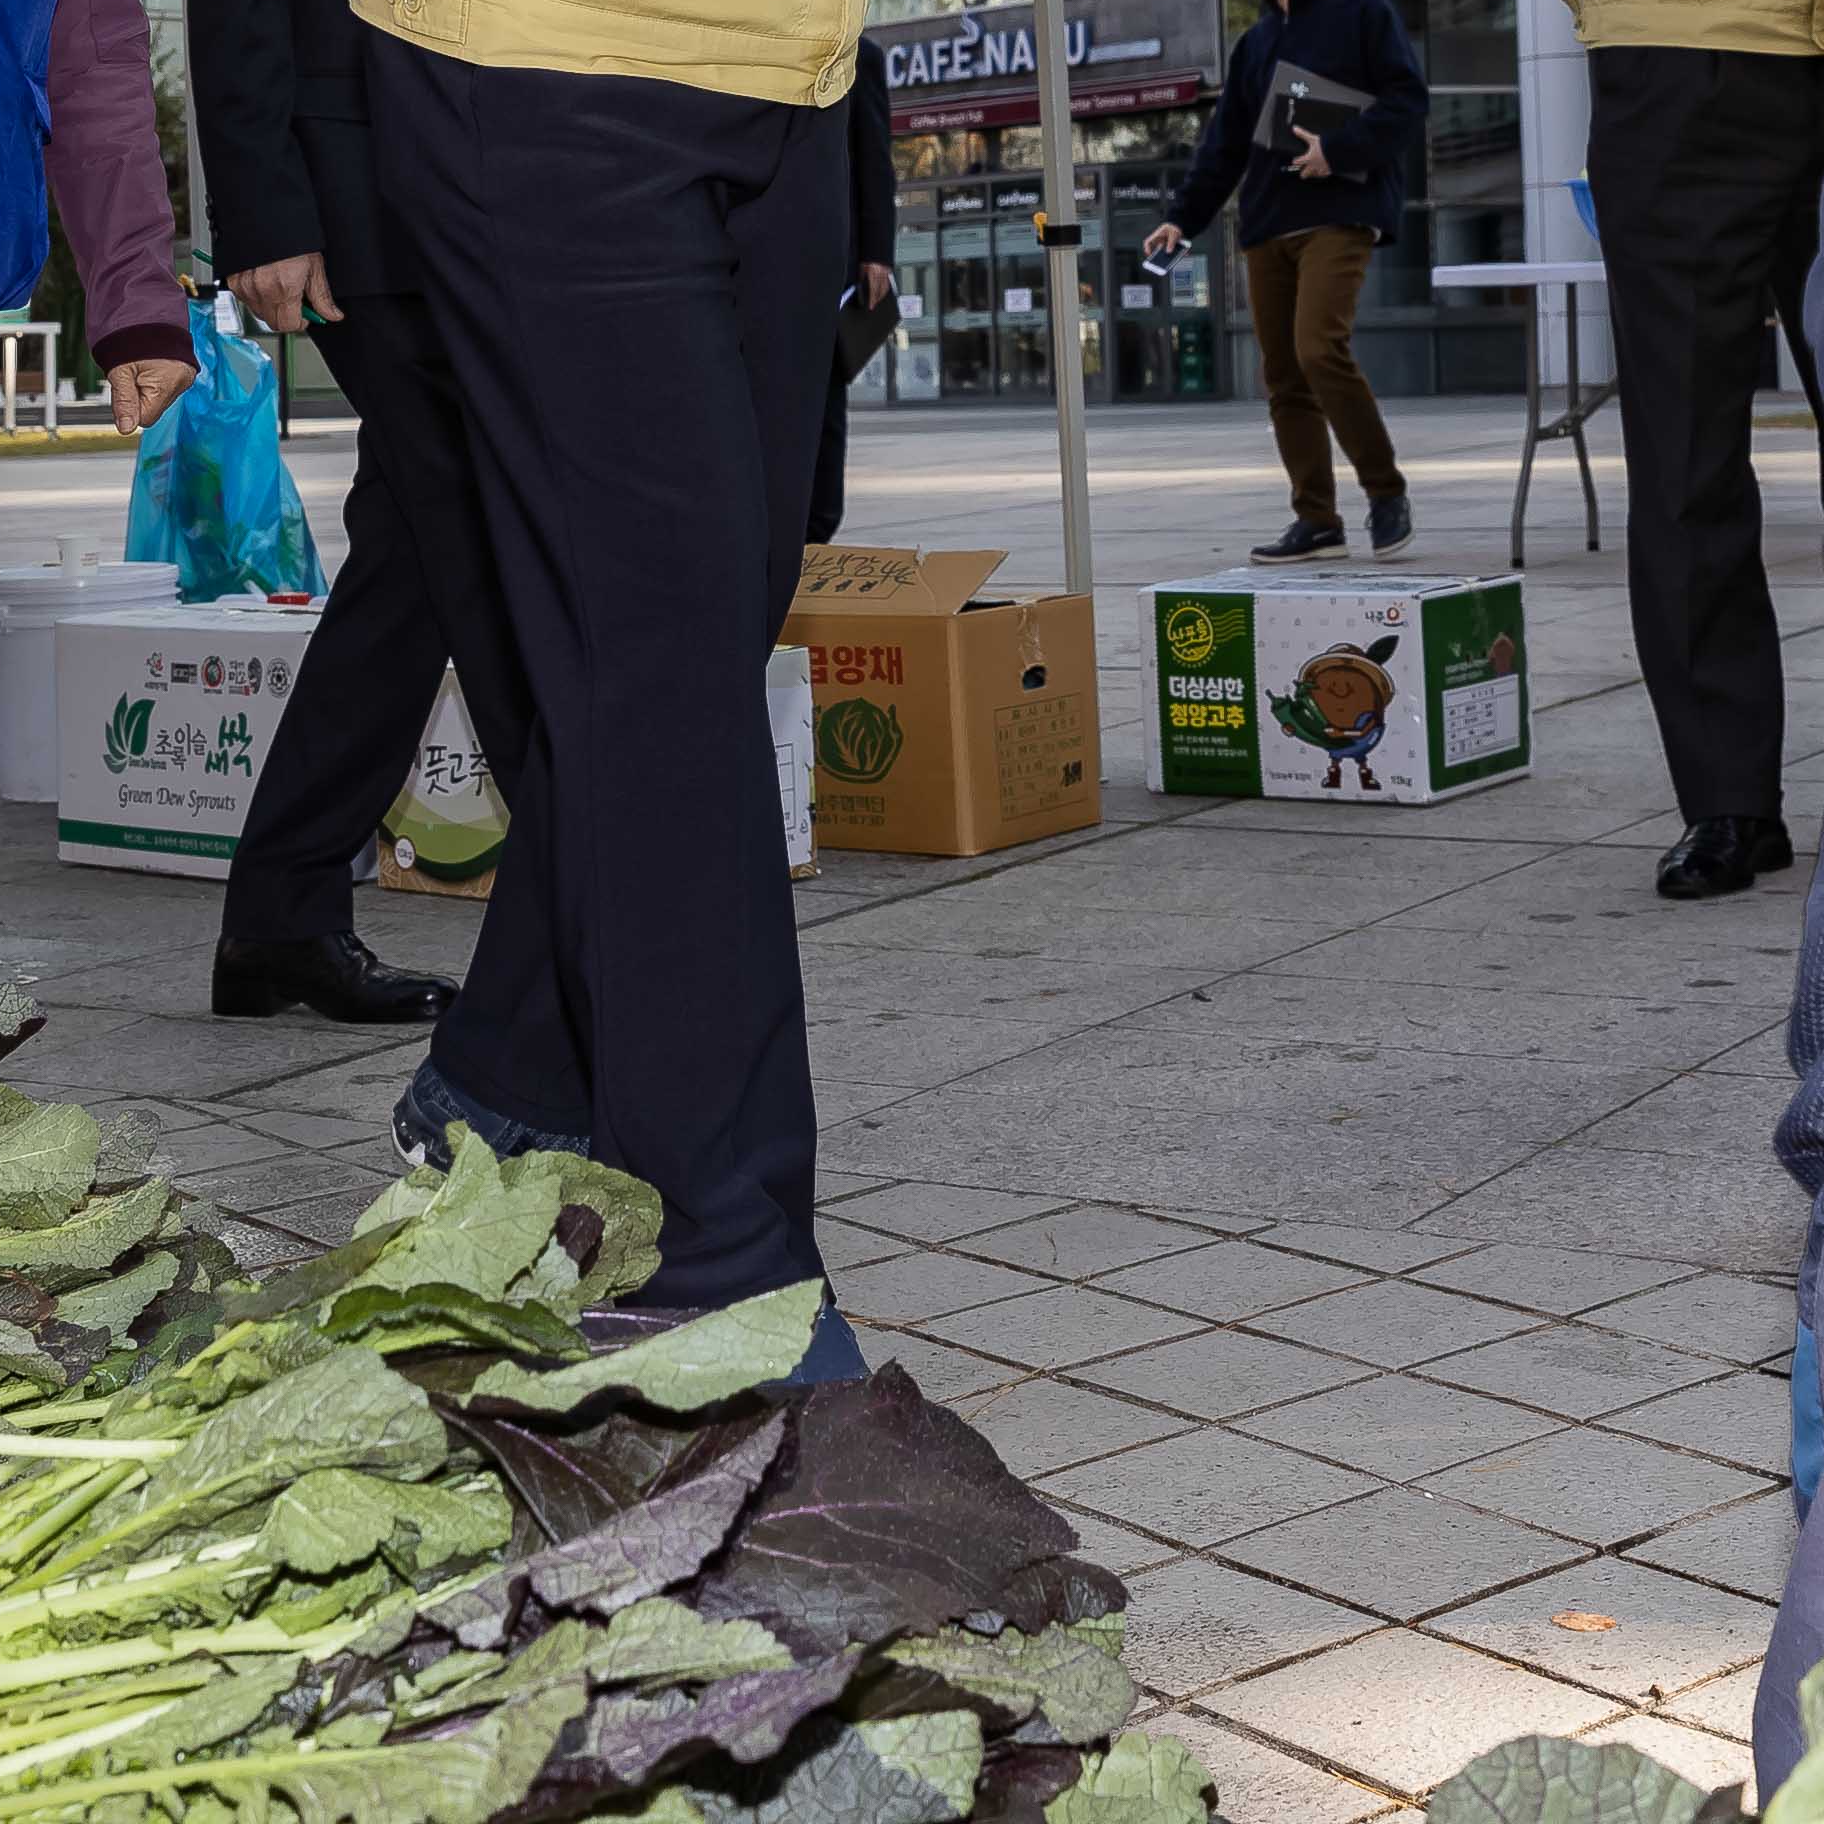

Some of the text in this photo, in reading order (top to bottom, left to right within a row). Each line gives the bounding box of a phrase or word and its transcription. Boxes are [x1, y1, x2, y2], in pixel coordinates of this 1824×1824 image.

[982, 20, 1088, 77] NAU
[1170, 703, 1246, 729] 청양고추
[424, 740, 491, 797] 풋고추
[118, 783, 237, 817] Green Dew Sprouts
